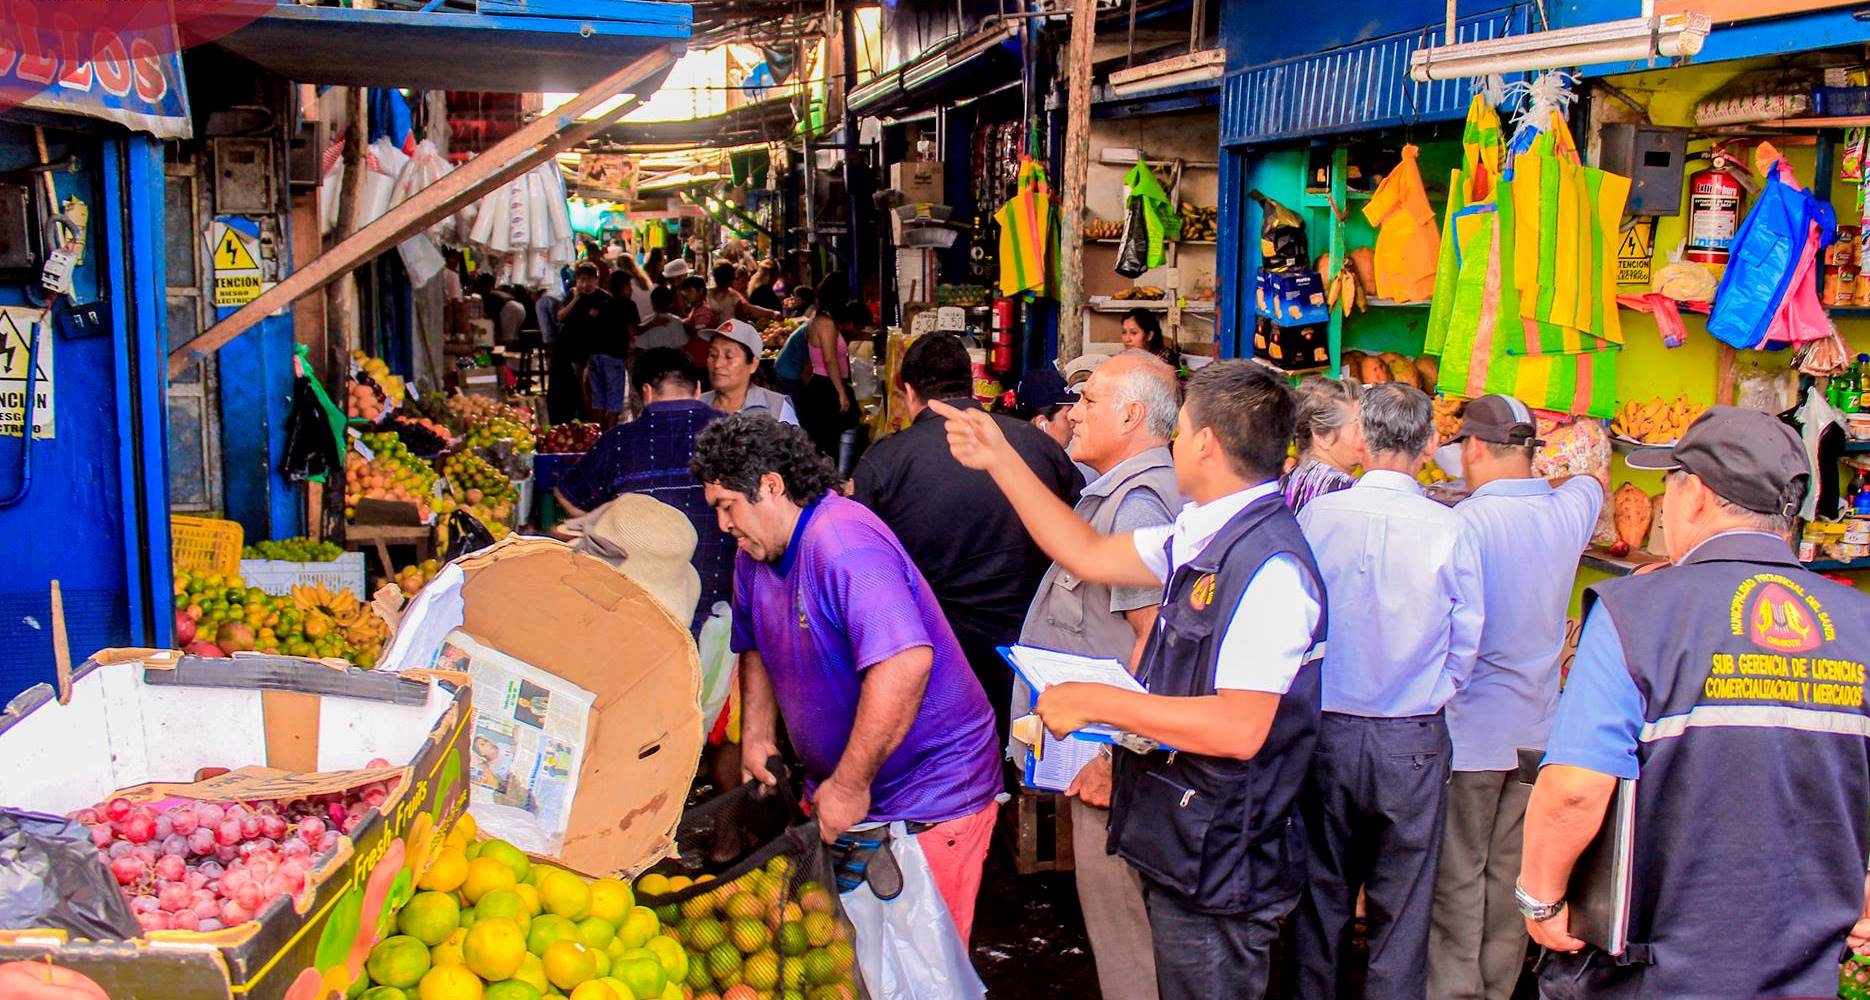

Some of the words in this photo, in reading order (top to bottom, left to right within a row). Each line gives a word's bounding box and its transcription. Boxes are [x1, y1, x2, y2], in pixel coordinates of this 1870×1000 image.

[0, 392, 47, 409] NCIN
[1730, 578, 1757, 636] MUNICIPALIDAD
[1754, 573, 1805, 597] PROVINCIAL
[1804, 594, 1822, 613] DEL
[1817, 611, 1836, 641] SANTA
[1711, 653, 1735, 675] SUB
[1738, 653, 1789, 677] GERENCIA
[1791, 657, 1808, 678] DE
[1811, 658, 1865, 685] LICENCIAS
[1705, 676, 1799, 702] COMERCIALIZACION
[1801, 681, 1811, 703] Y
[1812, 682, 1864, 707] MERCADOS
[353, 819, 393, 891] Fresh
[394, 780, 428, 836] Fruits
